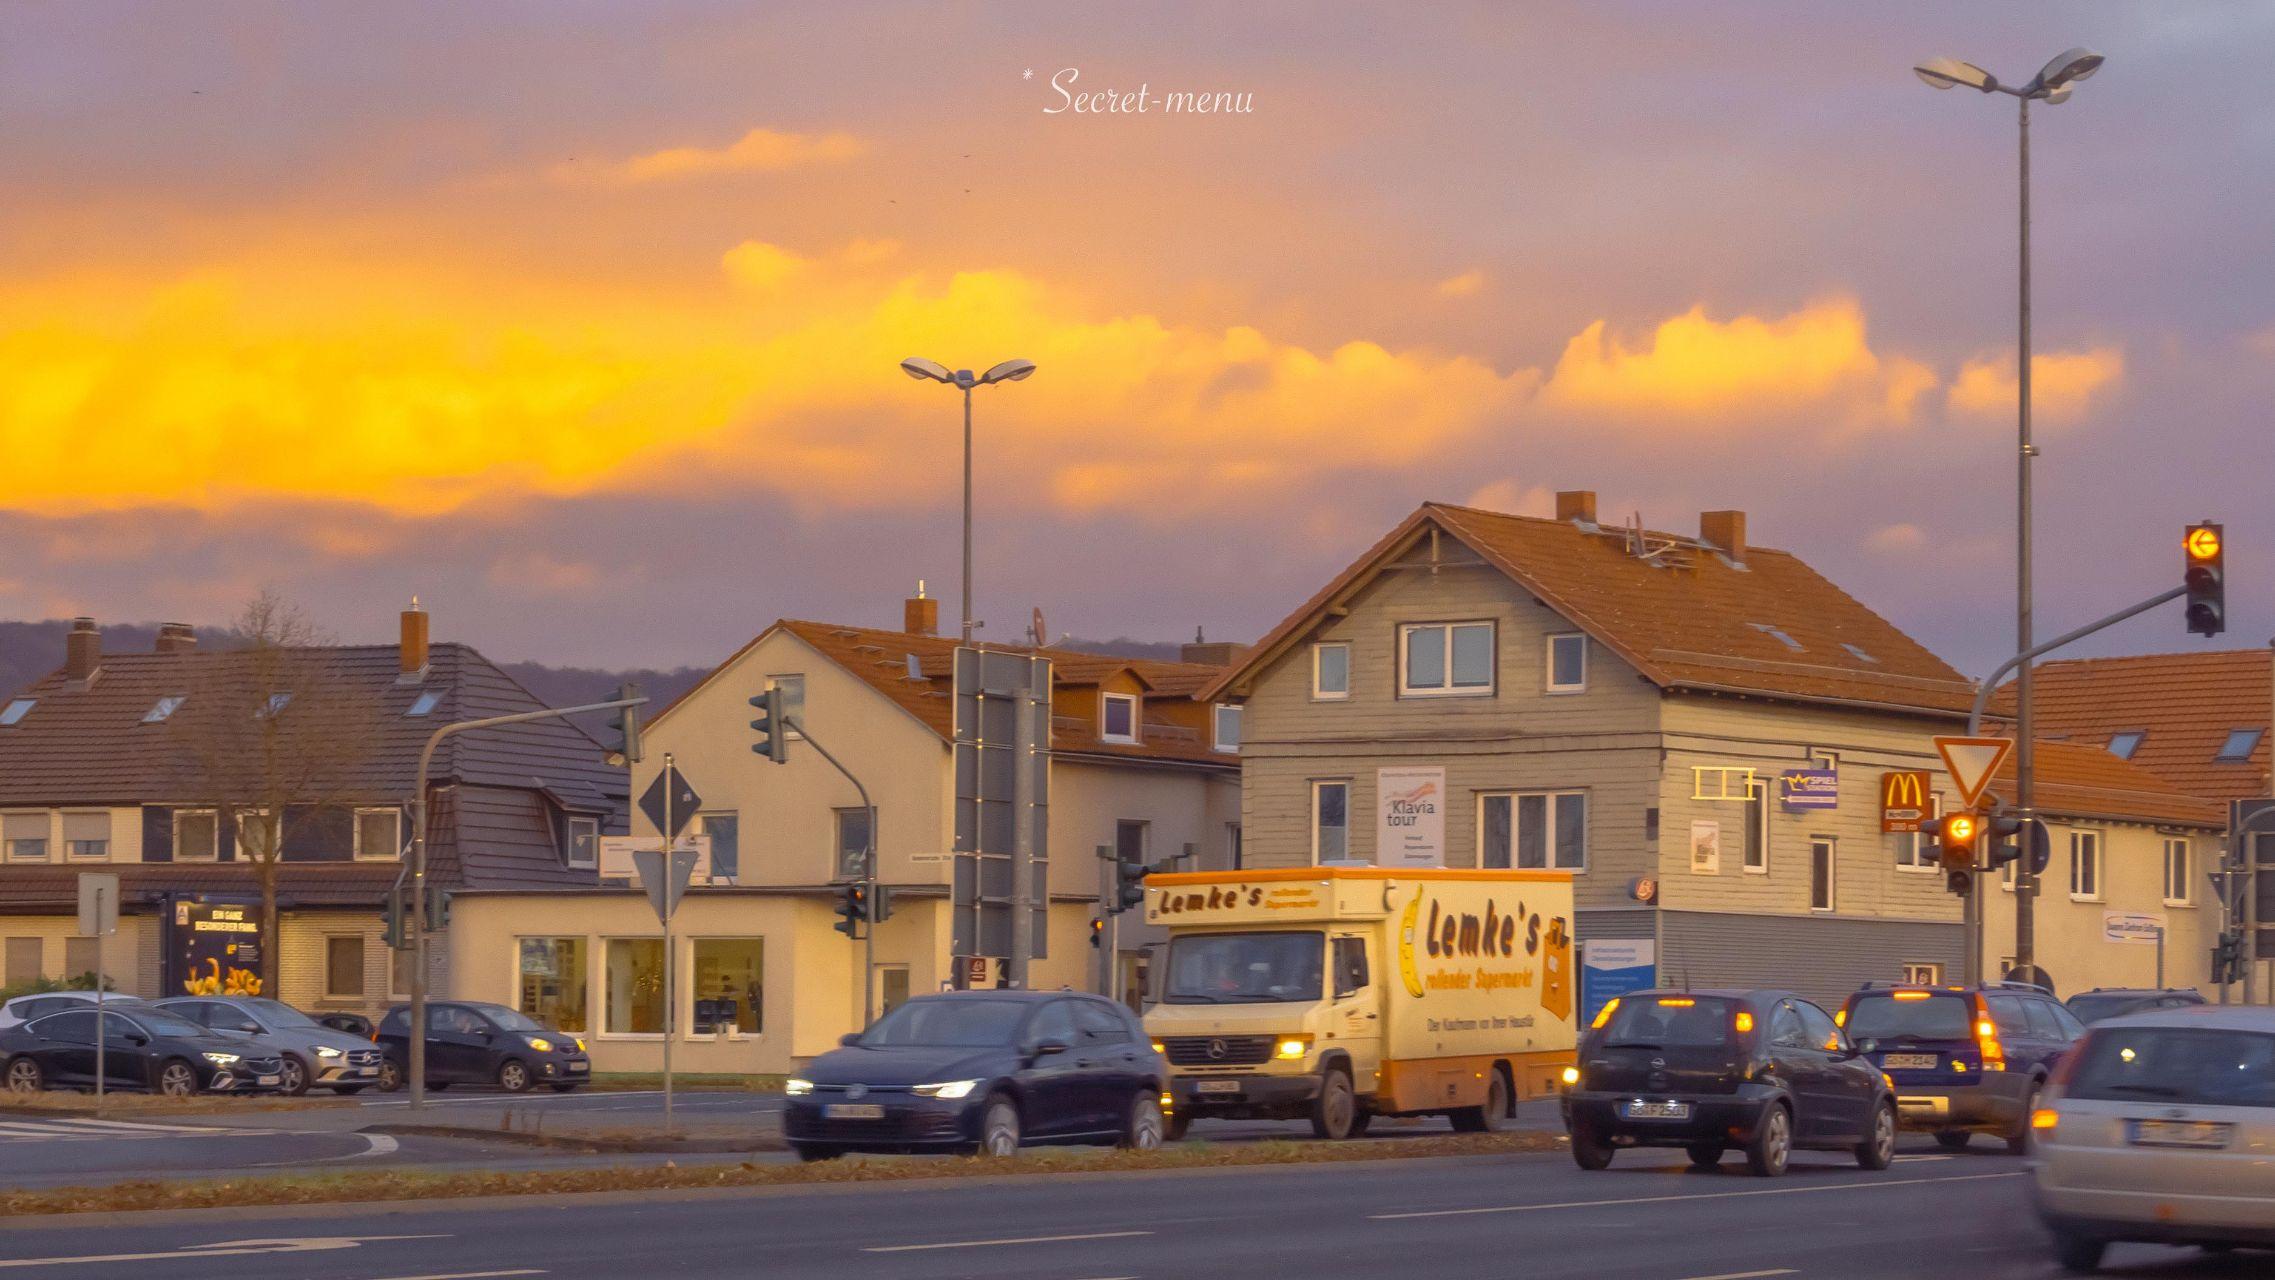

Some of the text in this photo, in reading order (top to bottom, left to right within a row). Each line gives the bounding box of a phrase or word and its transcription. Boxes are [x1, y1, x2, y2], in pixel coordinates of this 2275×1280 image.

[1809, 776, 1837, 785] SPIEL
[1391, 800, 1436, 814] Klavia
[1386, 813, 1418, 827] tour
[1159, 884, 1264, 914] Lemke's
[1426, 897, 1541, 959] Lemke's
[1425, 967, 1534, 993] rollender Supermarkt
